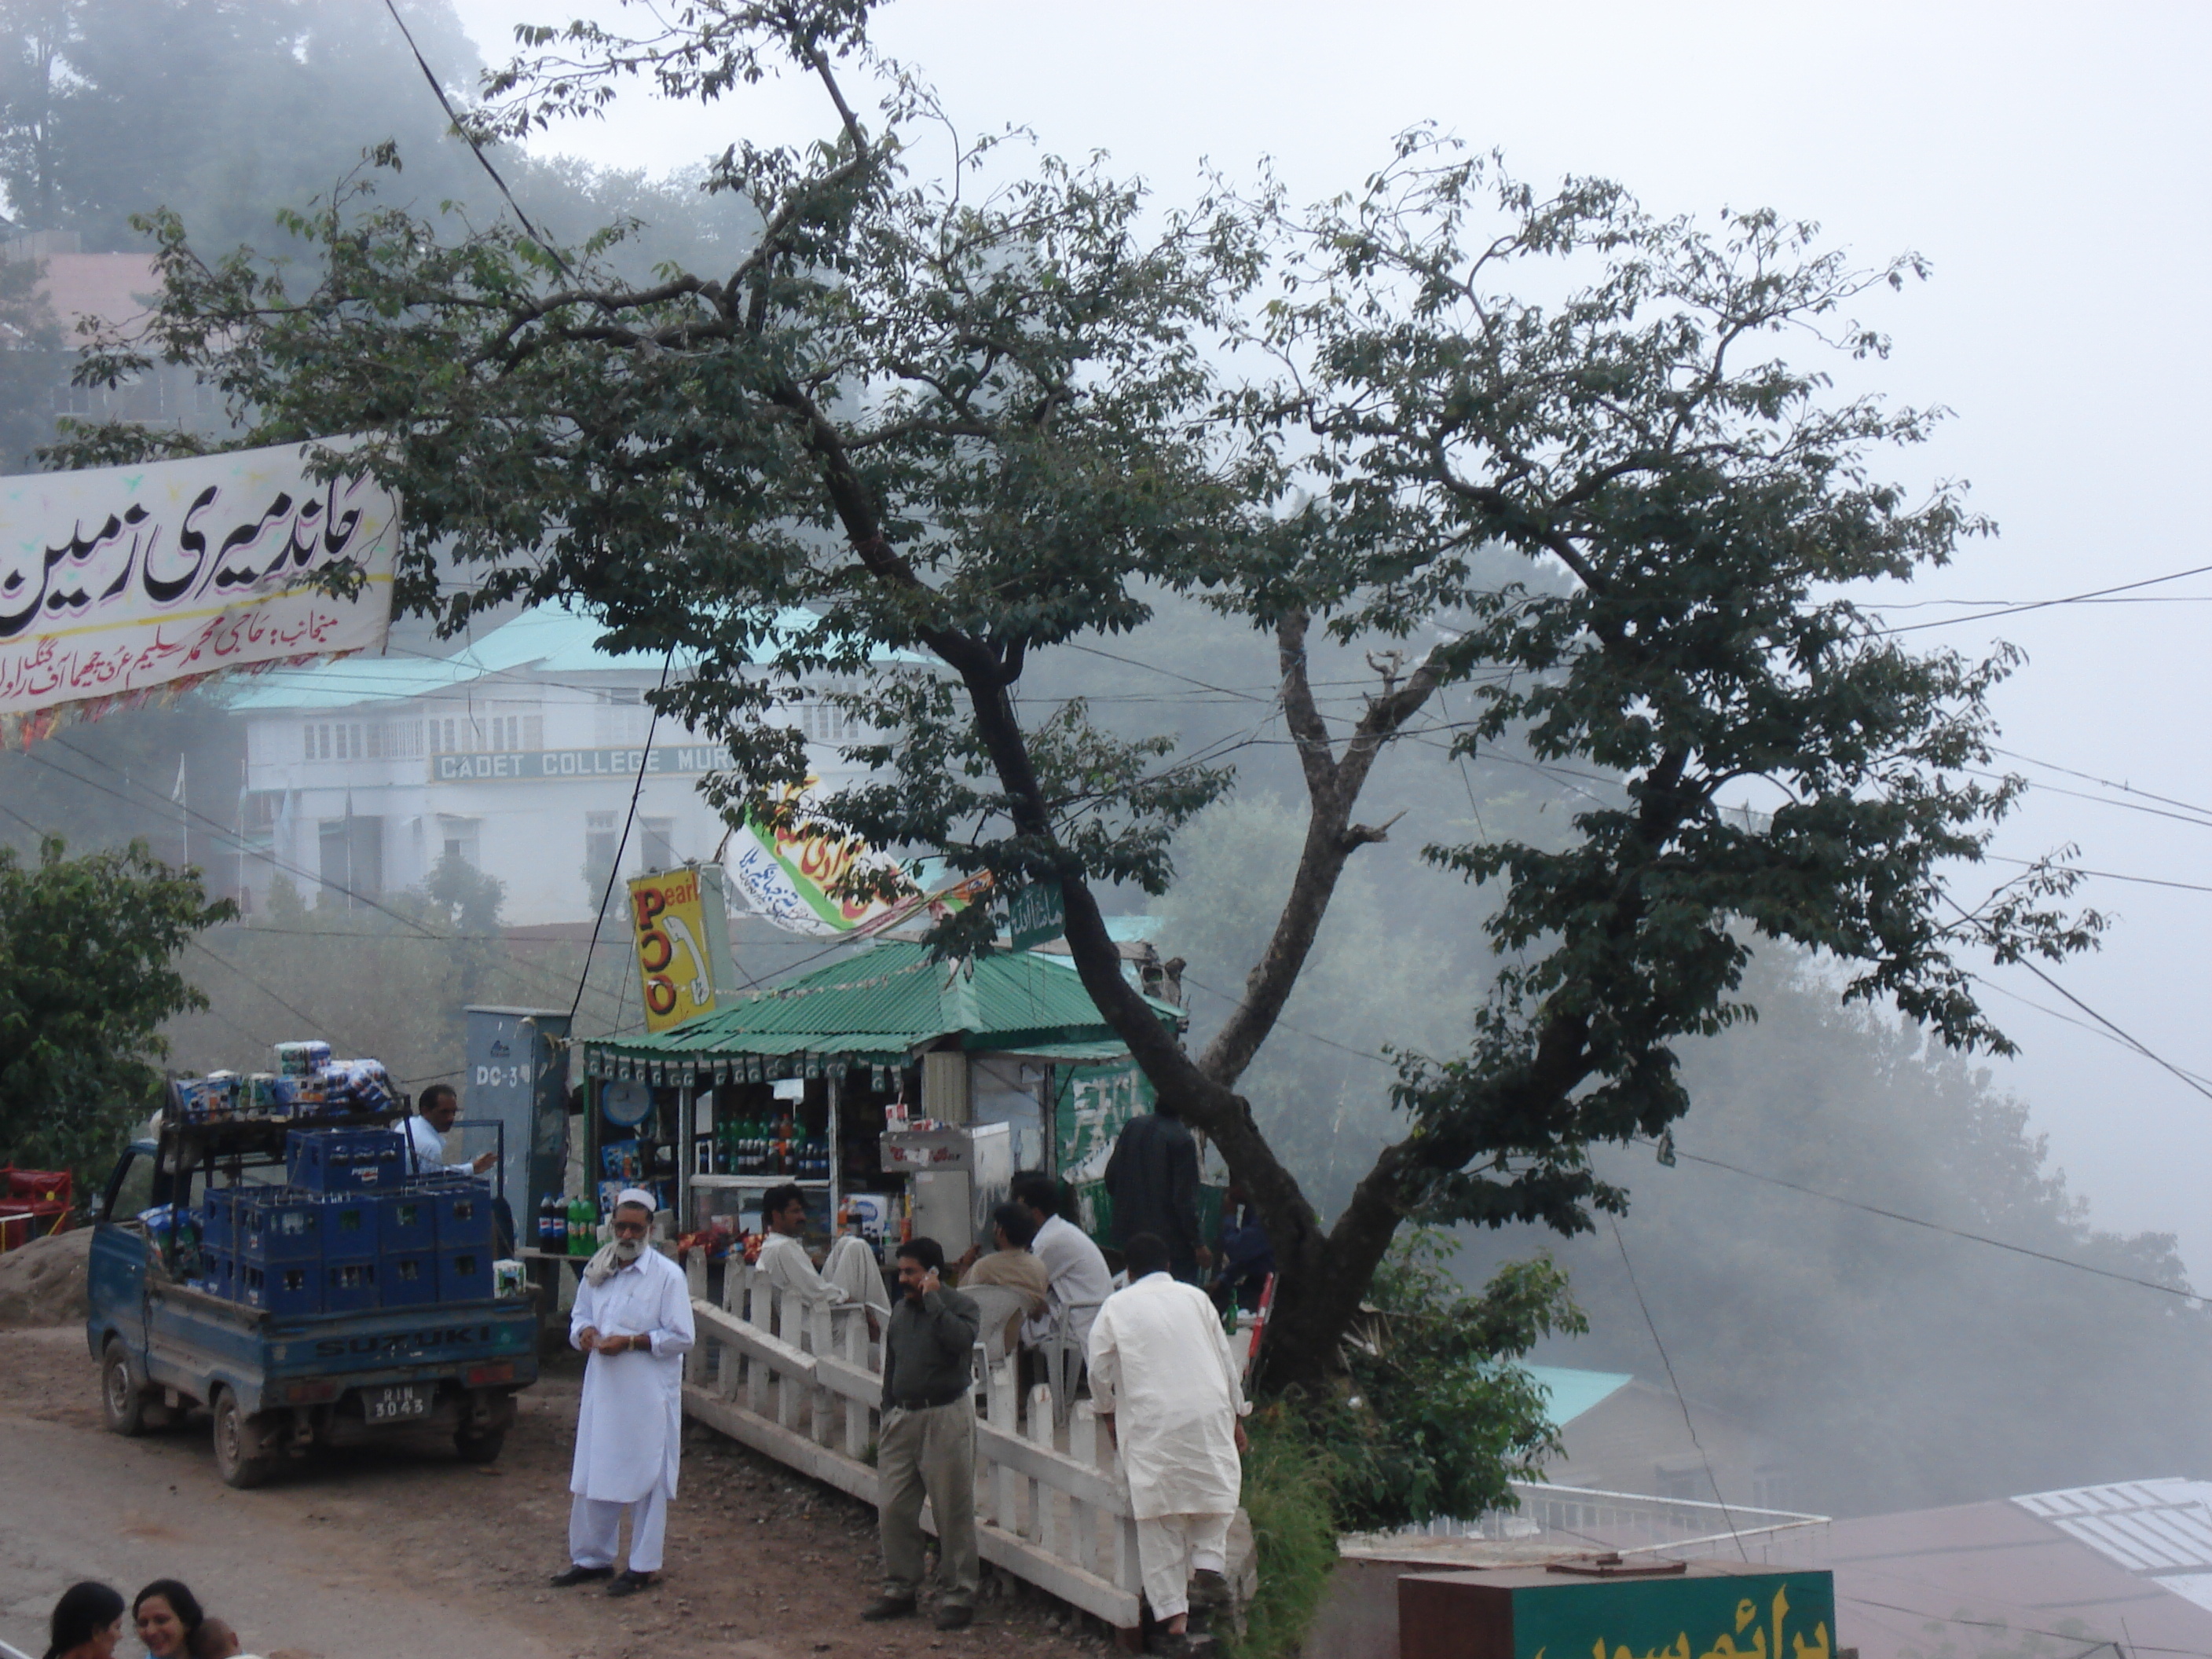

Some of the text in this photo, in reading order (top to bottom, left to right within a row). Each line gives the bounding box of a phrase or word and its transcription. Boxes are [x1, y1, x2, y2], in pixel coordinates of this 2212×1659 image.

[143, 485, 293, 602] میری
[214, 611, 269, 656] حاجی
[441, 754, 524, 778] CADET
[542, 749, 660, 775] COLLEGE
[316, 1325, 491, 1357] SUZUKI
